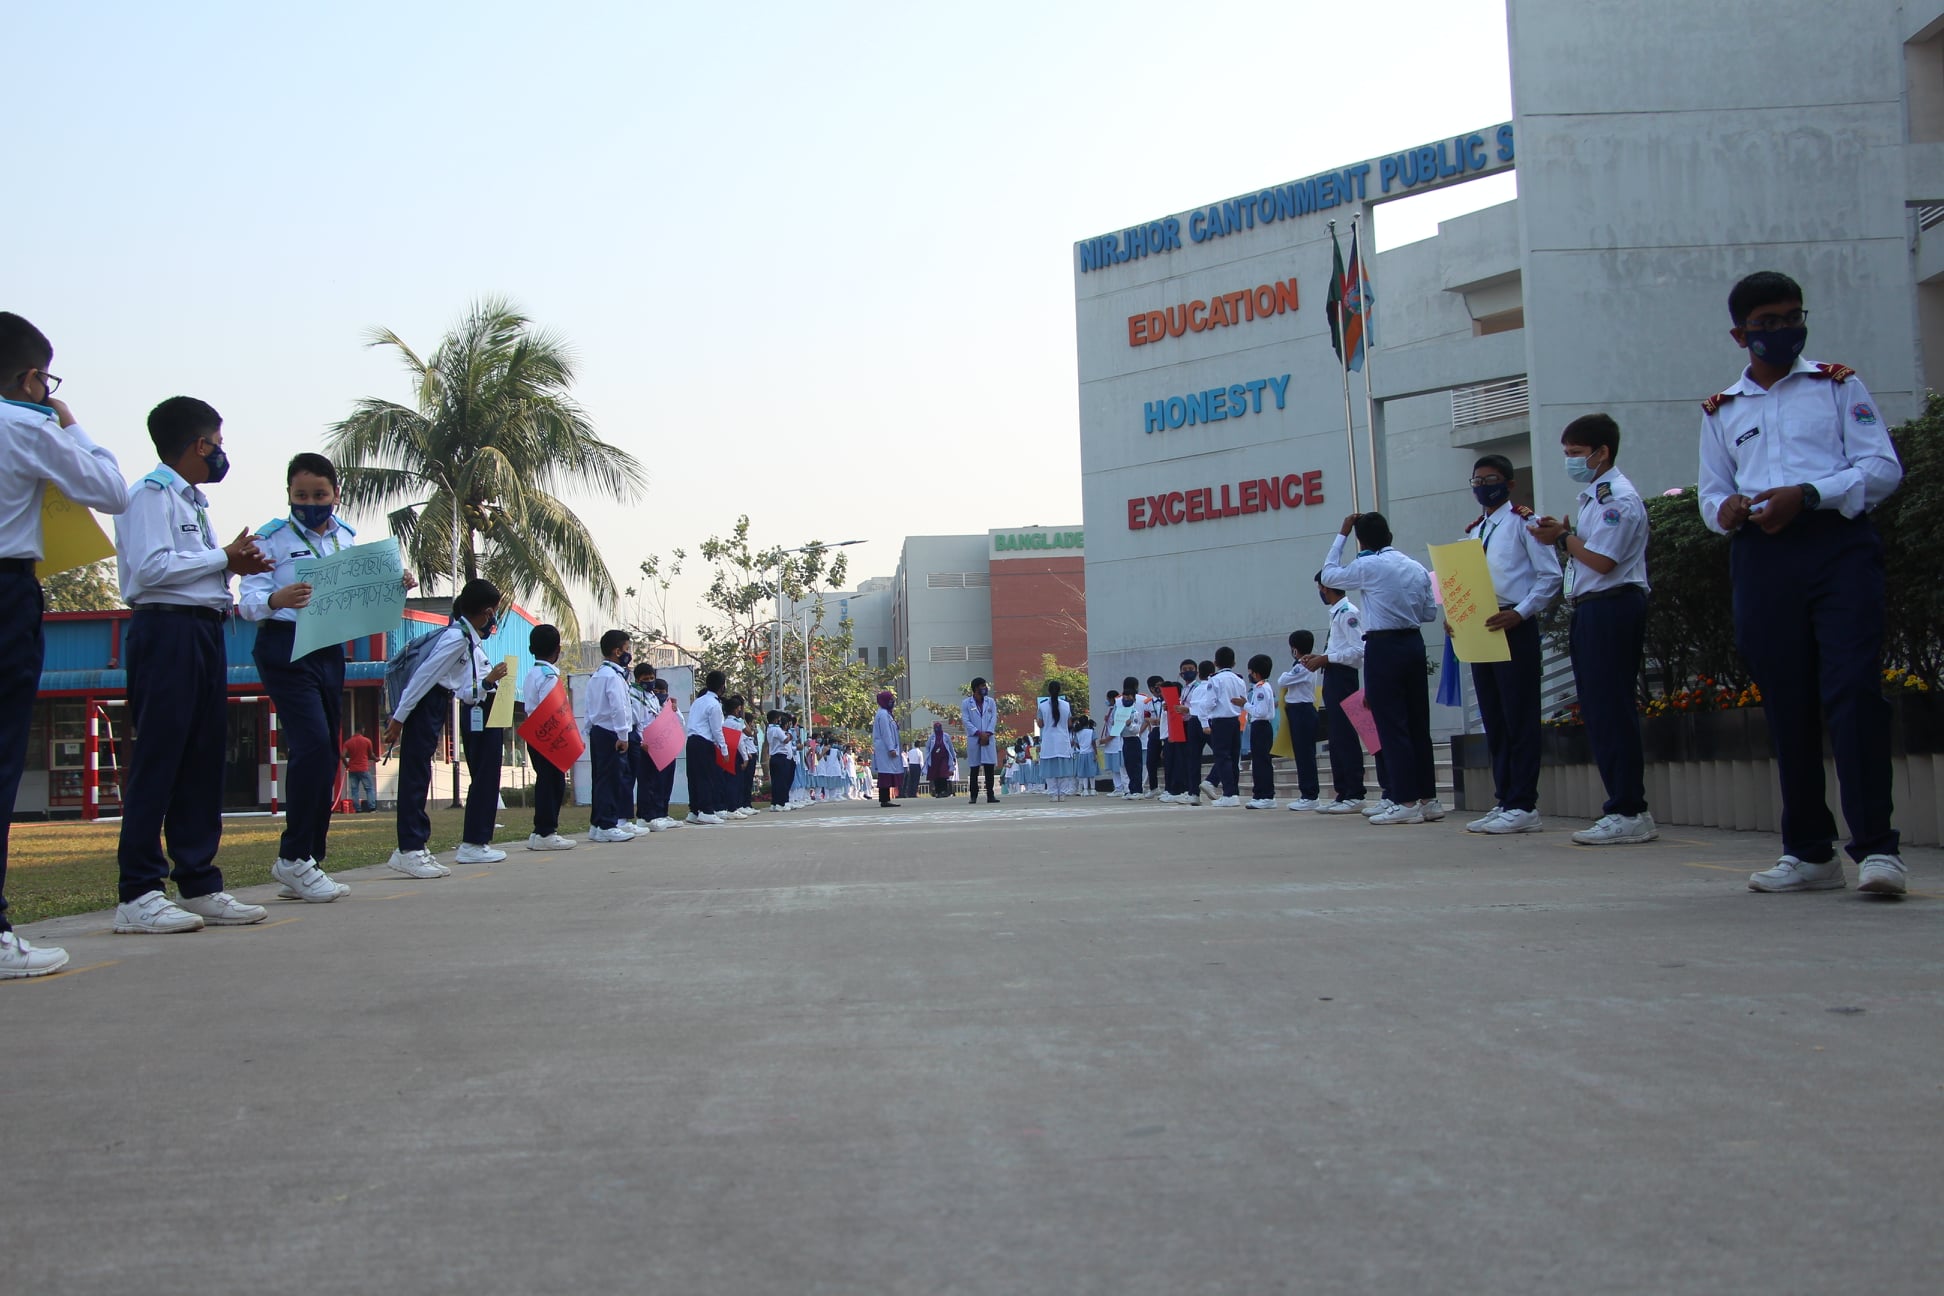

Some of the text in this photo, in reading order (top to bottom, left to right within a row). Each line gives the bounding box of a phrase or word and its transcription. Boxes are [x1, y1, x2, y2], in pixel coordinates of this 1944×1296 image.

[1080, 217, 1181, 273] NIRJHOR
[1189, 163, 1370, 243] CANTONMENT
[1380, 134, 1487, 193] PUBLIC
[1128, 277, 1298, 347] EDUCATION
[1144, 374, 1291, 433] HONESTY
[1128, 470, 1323, 530] EXCELLENCE
[994, 532, 1084, 551] BANGLADE
